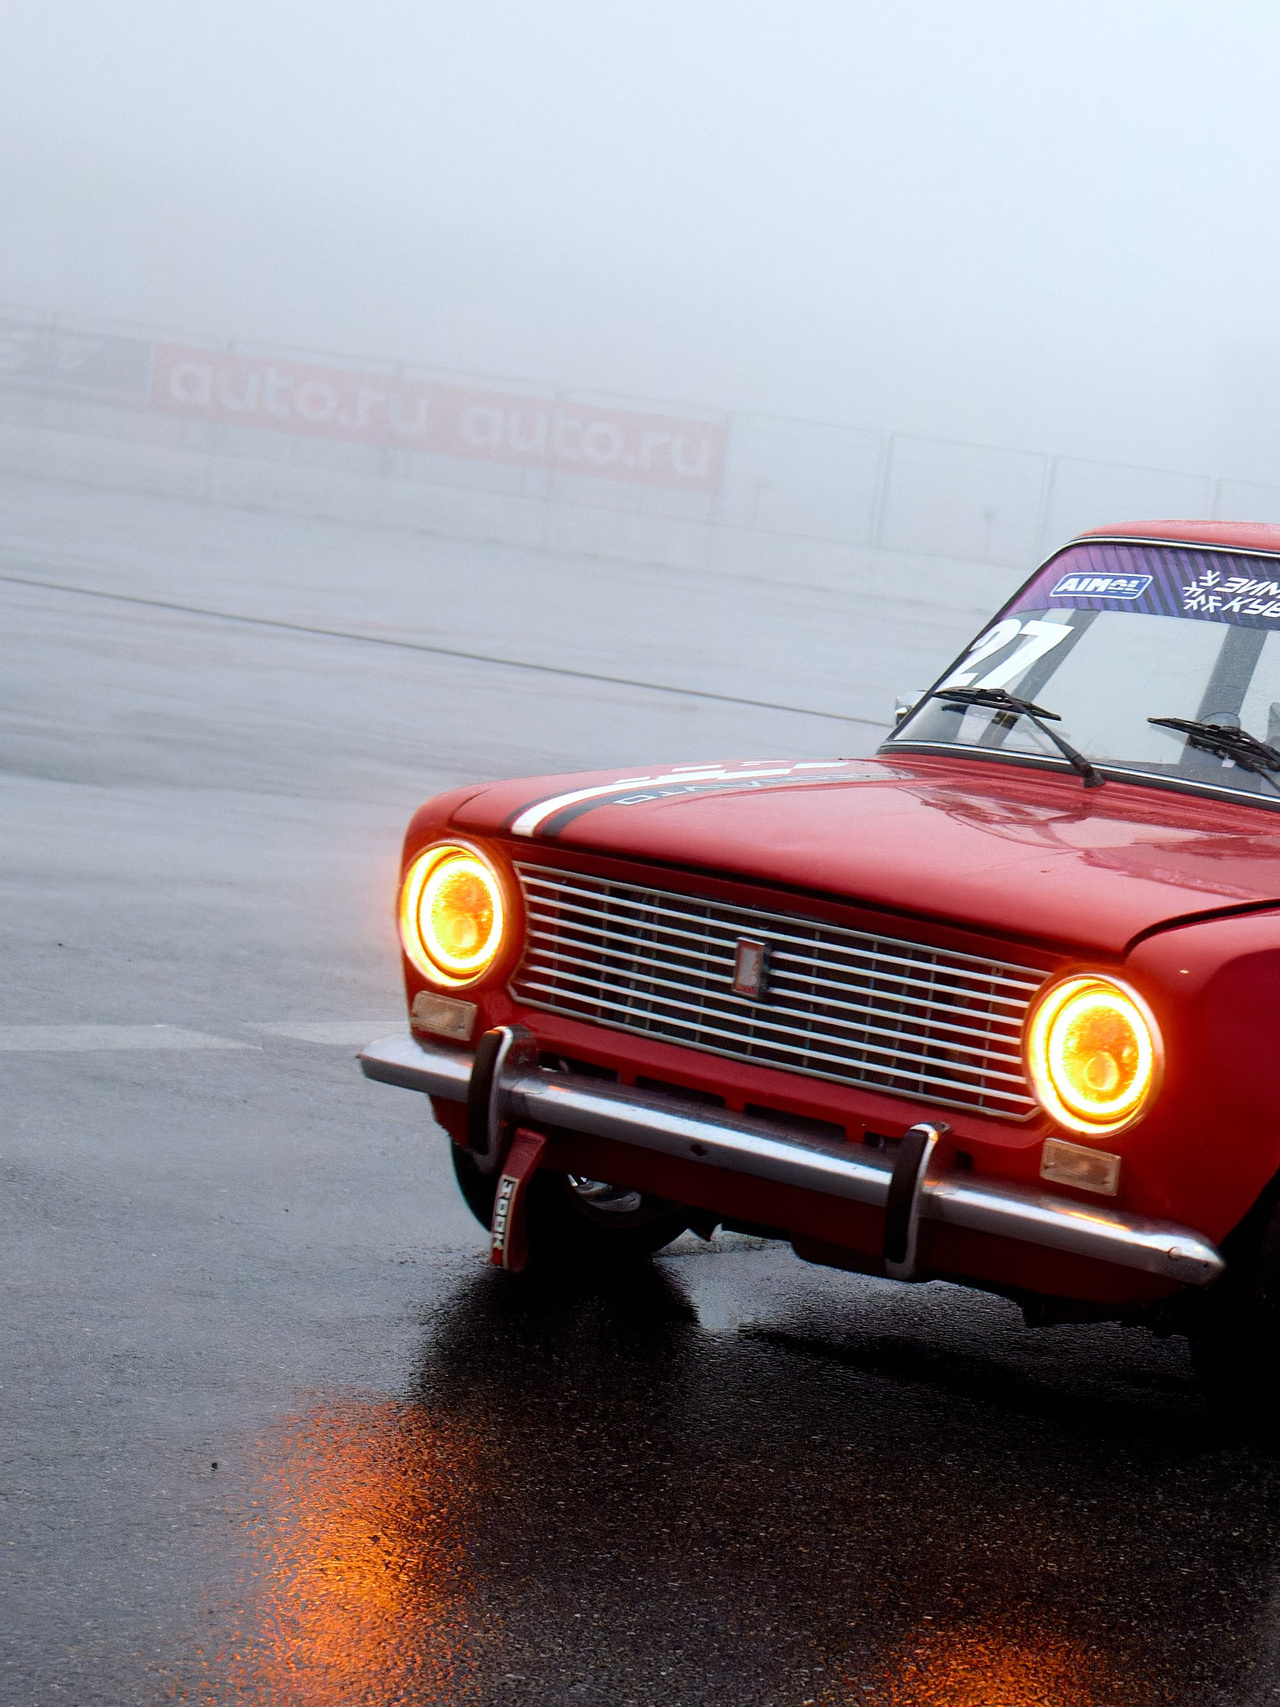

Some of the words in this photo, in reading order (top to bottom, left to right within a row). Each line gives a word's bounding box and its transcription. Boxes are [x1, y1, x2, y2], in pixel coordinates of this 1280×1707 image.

[168, 359, 430, 435] auto.ru
[460, 402, 713, 475] auto.ru
[1055, 577, 1140, 595] AIMOL
[934, 618, 1076, 691] 27
